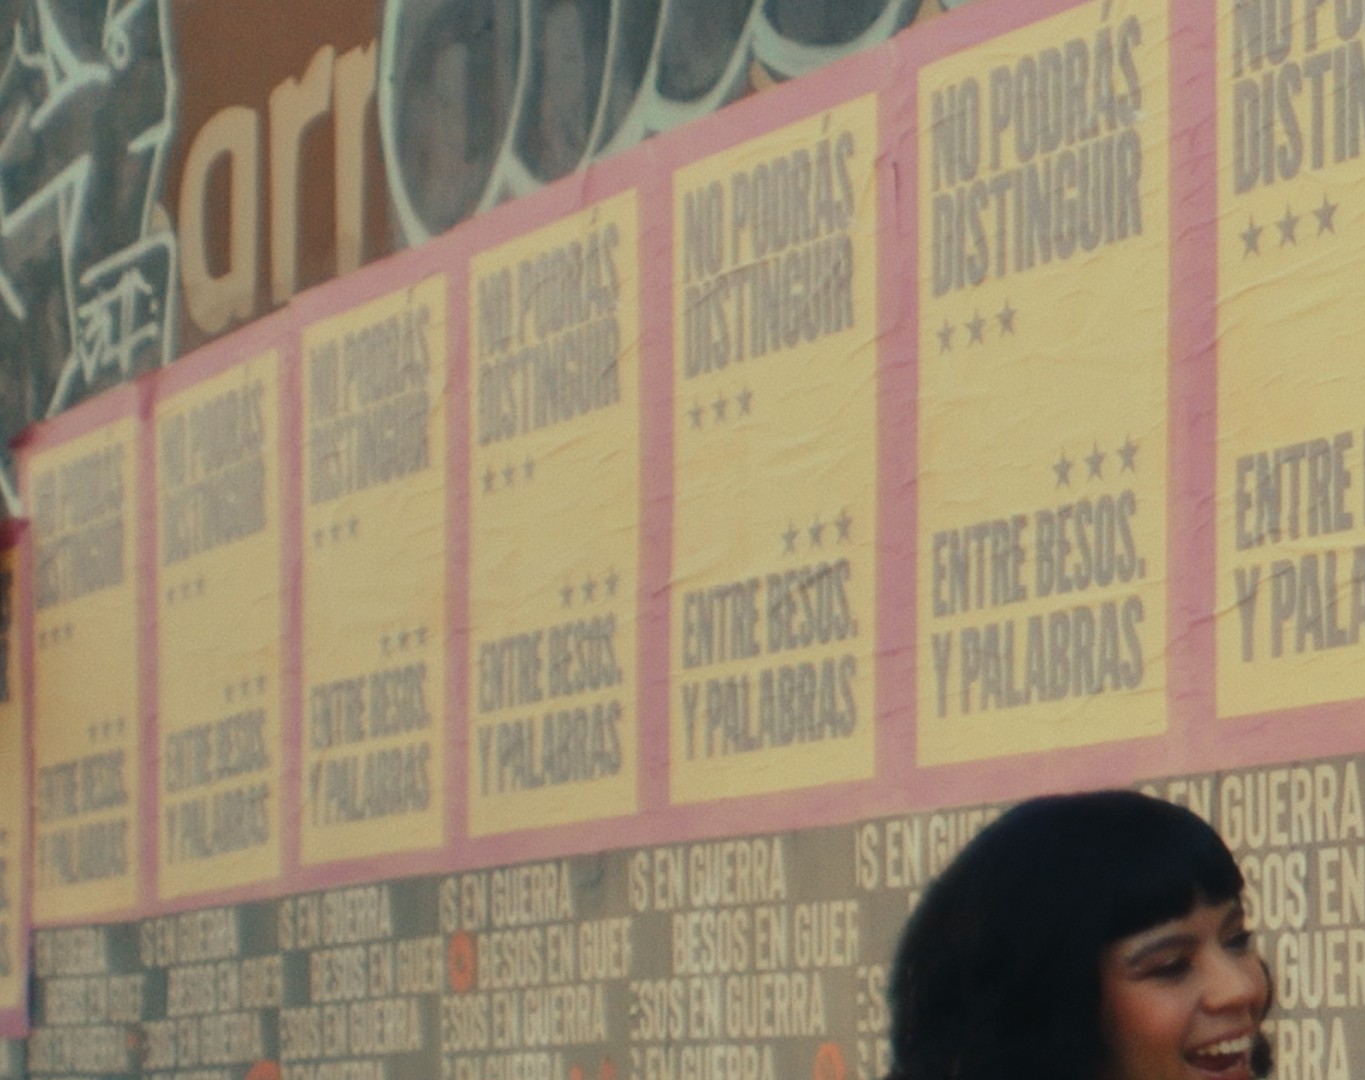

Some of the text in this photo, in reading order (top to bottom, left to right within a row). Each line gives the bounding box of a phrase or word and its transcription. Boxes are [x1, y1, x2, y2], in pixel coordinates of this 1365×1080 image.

[931, 2, 1143, 193] NO PODRÁS
[684, 113, 854, 285] NO PODRÁS
[931, 128, 1143, 298] DISTINGUIR
[684, 234, 855, 380] DISTINGUIR
[1236, 430, 1354, 551] ENTRE
[932, 489, 1145, 618] ENTRE BESOS.
[683, 557, 858, 669] ENTRE BESOS.
[931, 594, 1145, 718] Y PALABRAS
[1234, 564, 1262, 663] Y
[478, 700, 623, 797] Y PALABRAS
[682, 653, 857, 760] Y PALABRAS
[886, 819, 921, 888] EN
[1220, 761, 1365, 852] GUERRA
[654, 847, 684, 911] EN
[689, 836, 787, 907] GUERRA
[672, 907, 750, 976] BESOS
[755, 904, 787, 970] EN
[689, 976, 721, 1039] EN
[726, 971, 826, 1038] GUERRA
